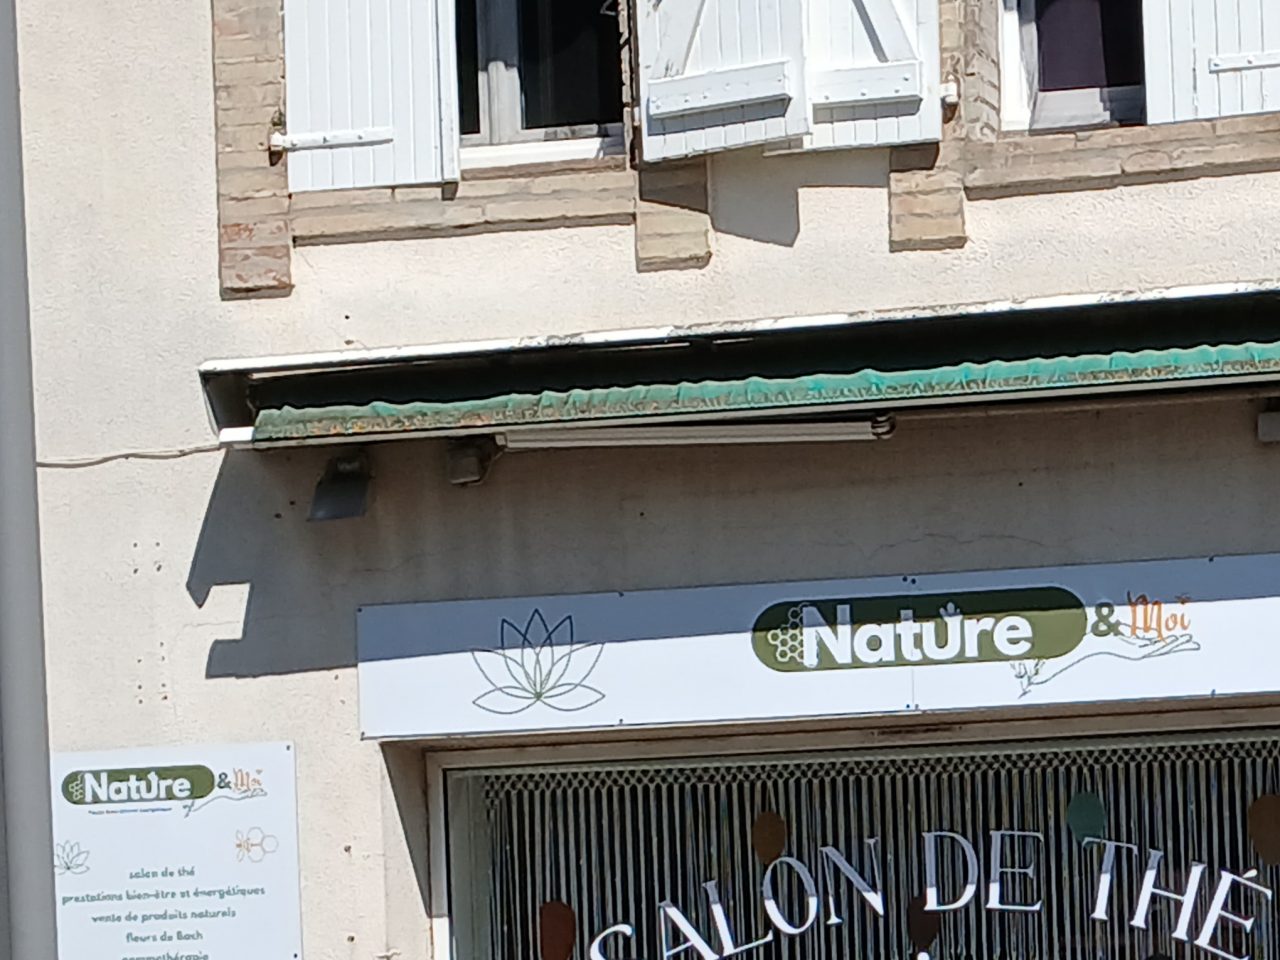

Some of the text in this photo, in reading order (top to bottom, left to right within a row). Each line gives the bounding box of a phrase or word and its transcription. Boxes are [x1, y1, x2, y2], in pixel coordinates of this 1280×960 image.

[801, 590, 1192, 666] Nature & Moi
[83, 771, 192, 803] Nature
[217, 772, 231, 789] &
[161, 866, 175, 878] de
[177, 865, 196, 878] thé
[922, 829, 1045, 912] DE
[124, 911, 138, 922] de
[160, 930, 174, 942] de
